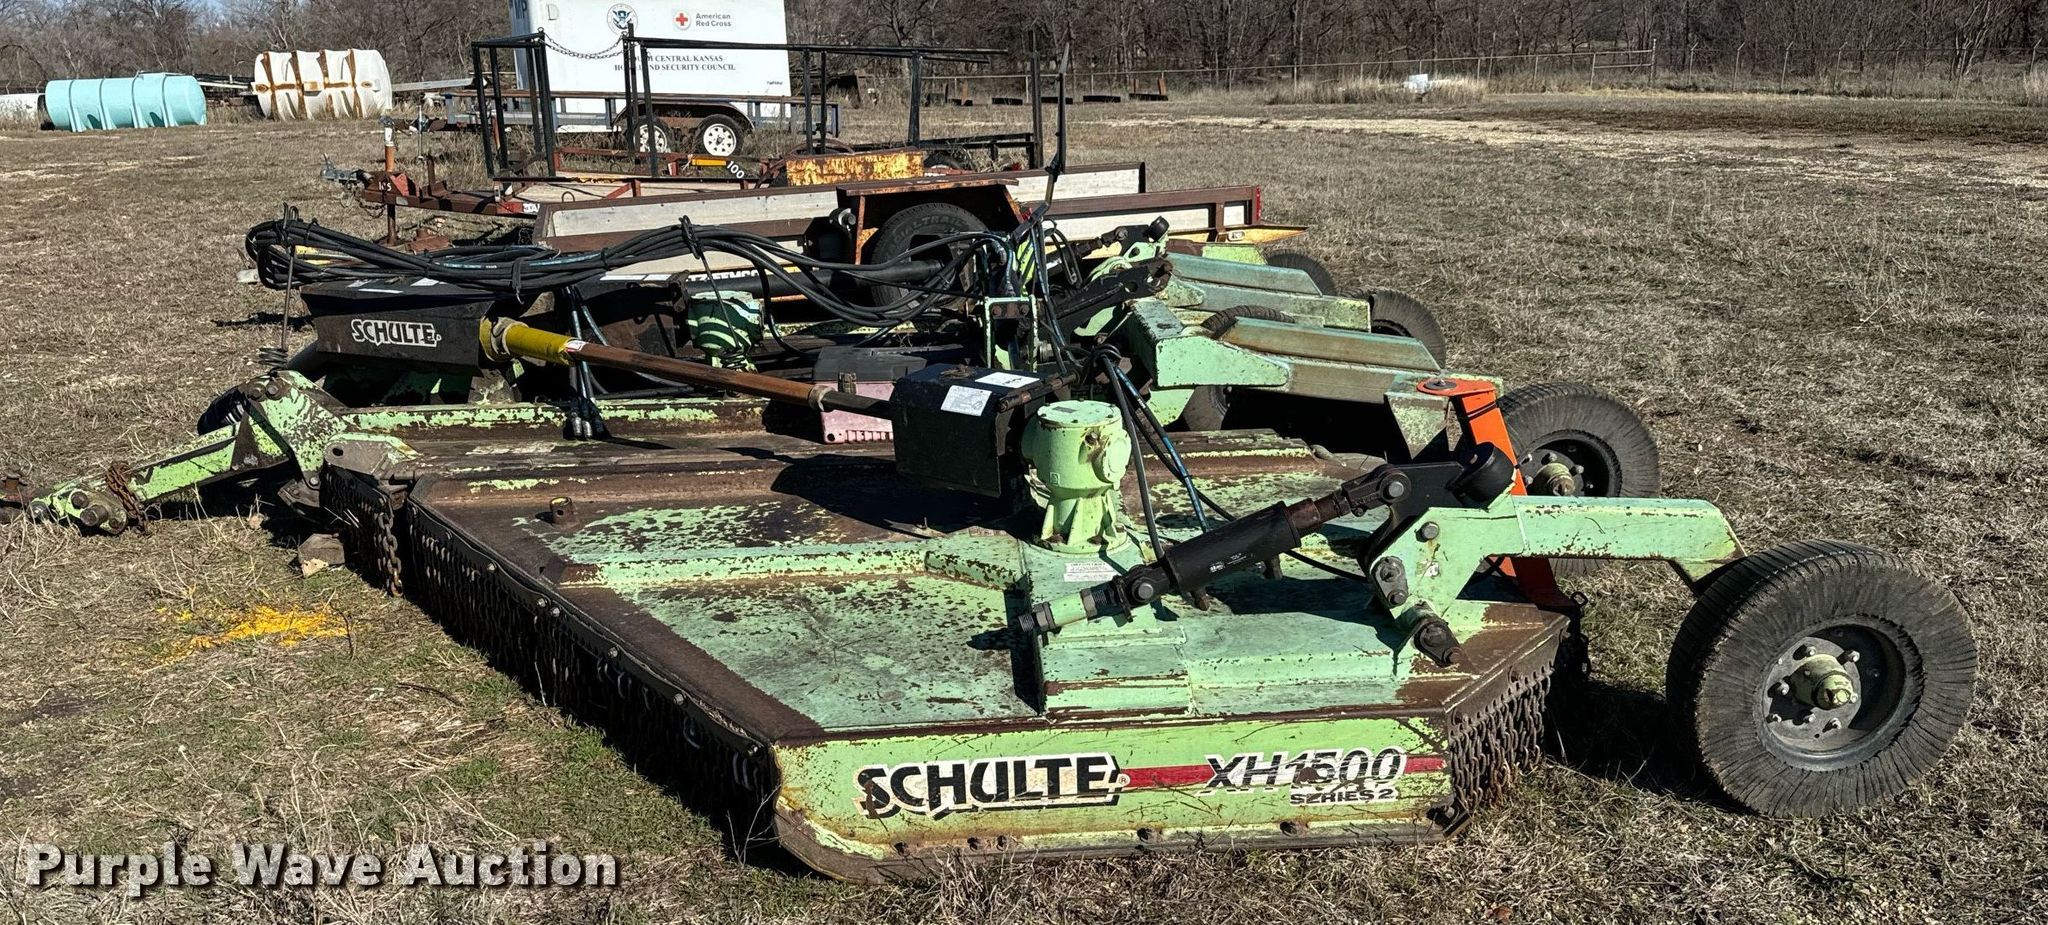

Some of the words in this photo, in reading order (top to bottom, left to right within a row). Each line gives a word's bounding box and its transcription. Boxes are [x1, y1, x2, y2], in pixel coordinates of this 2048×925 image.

[661, 63, 700, 71] SECURITY
[701, 63, 736, 71] COUNCIL
[693, 54, 723, 62] KANSAS
[726, 160, 745, 179] 100
[351, 318, 437, 347] SCHULTE
[1205, 747, 1405, 790] XH1500
[854, 752, 1120, 820] SCHULTE
[1291, 789, 1374, 805] SERIES
[1378, 788, 1395, 800] 2
